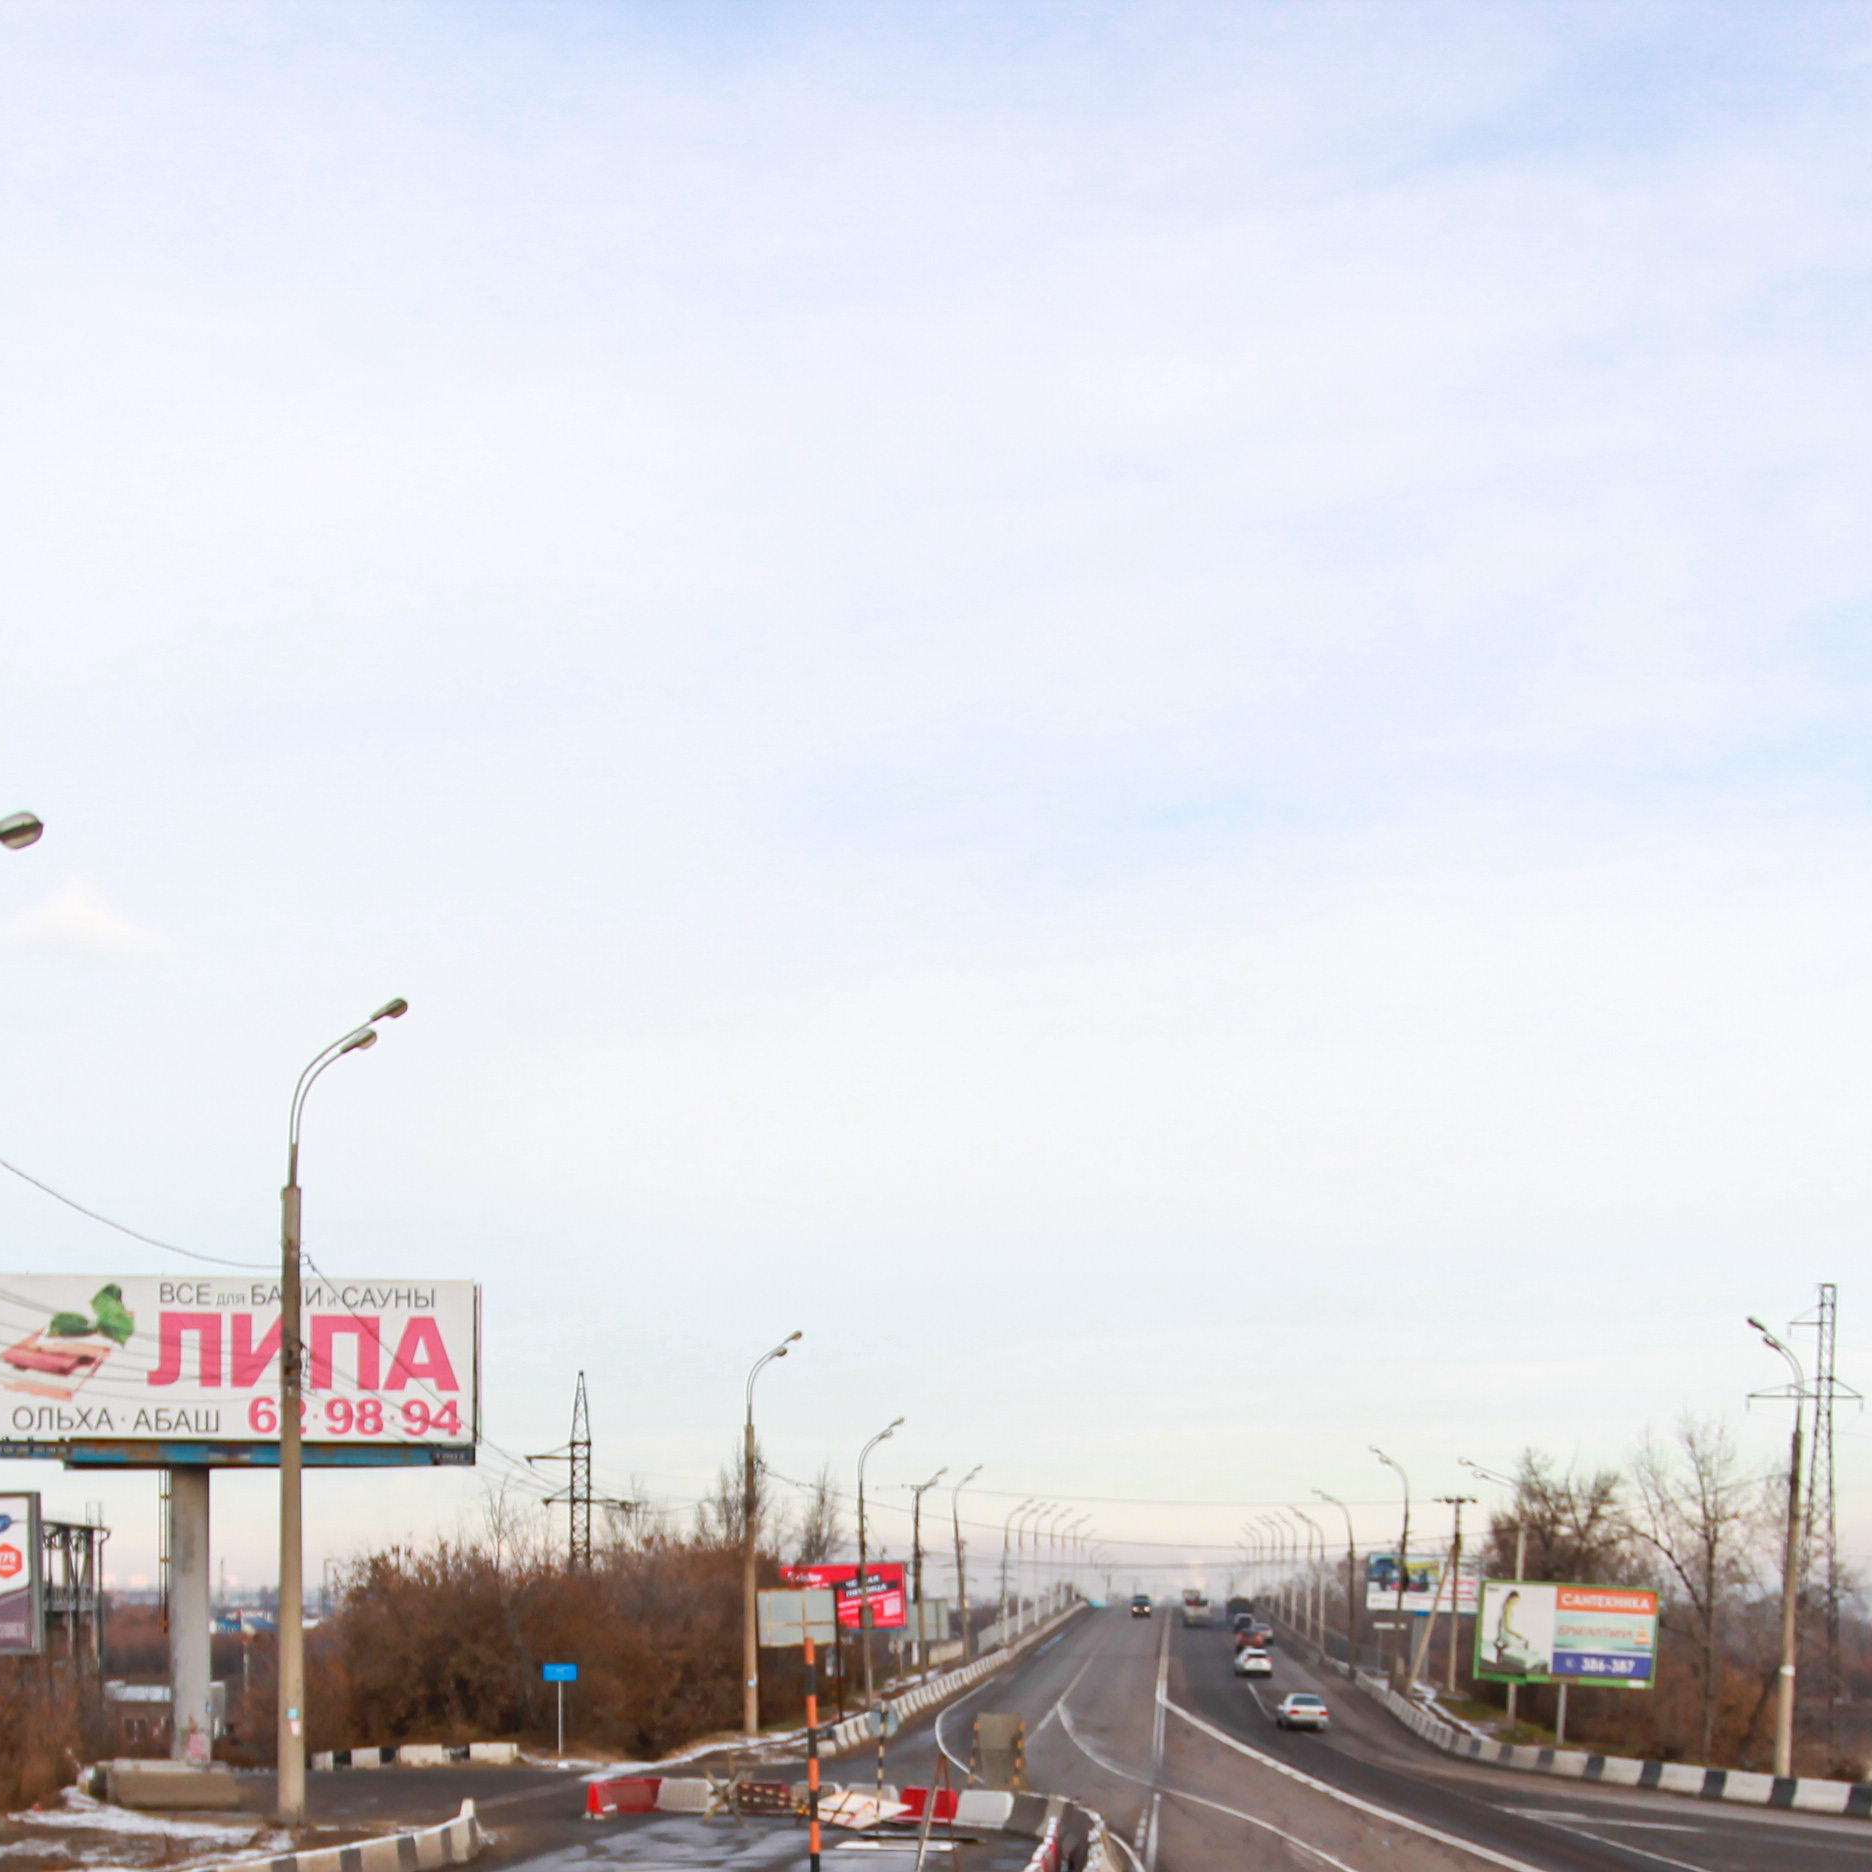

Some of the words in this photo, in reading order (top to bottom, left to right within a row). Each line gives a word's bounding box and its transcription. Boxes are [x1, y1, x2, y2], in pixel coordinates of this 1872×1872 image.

[159, 1283, 211, 1305] ВСЕ
[216, 1292, 245, 1306] для
[250, 1284, 322, 1307] БАИ
[341, 1287, 435, 1309] САУНЫ
[146, 1311, 460, 1391] ЛИПА
[12, 1406, 114, 1431] ОЛЬХА
[133, 1407, 220, 1433] АБАШ
[1561, 1593, 1650, 1610] САНТЕХНИКА
